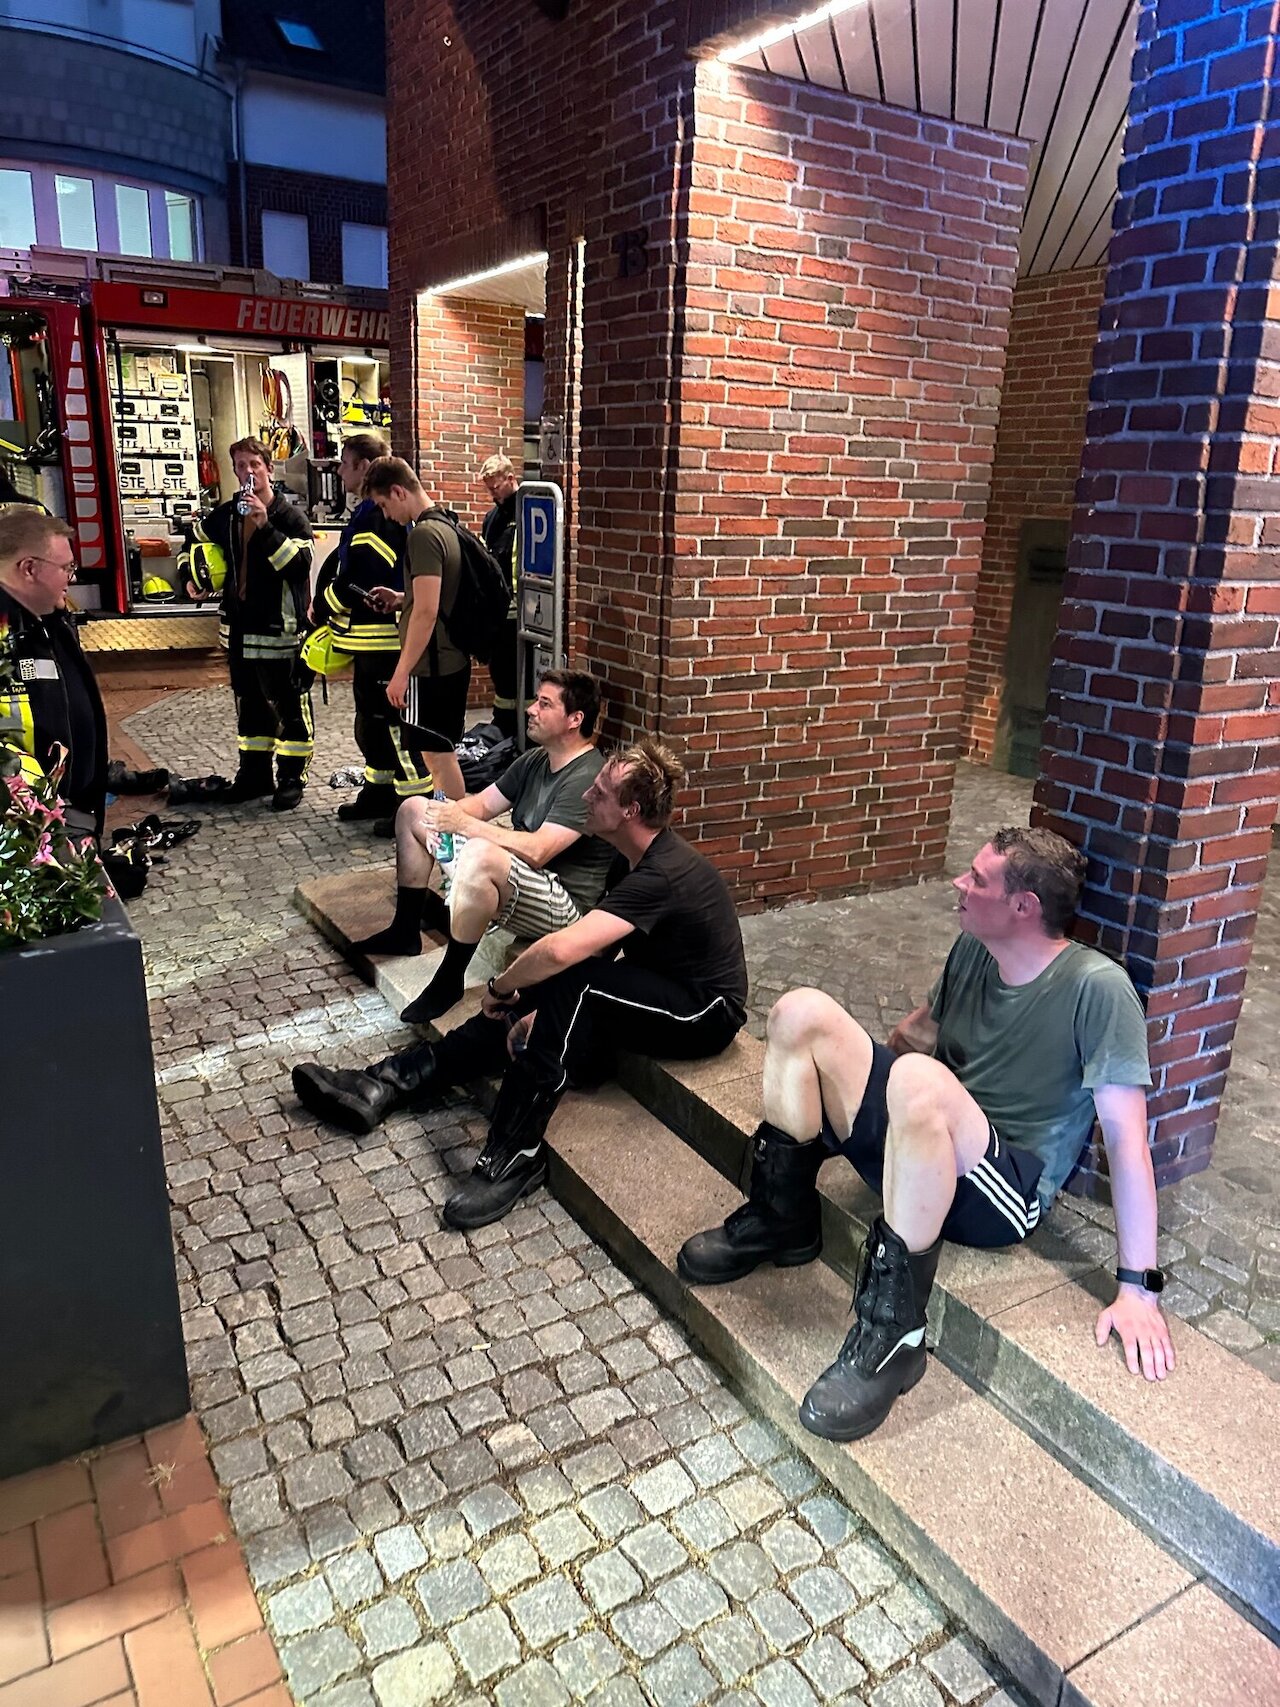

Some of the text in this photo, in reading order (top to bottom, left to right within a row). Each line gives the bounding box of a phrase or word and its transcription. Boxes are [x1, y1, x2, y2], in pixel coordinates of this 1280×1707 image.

[237, 299, 390, 341] FEUERWEHR
[120, 476, 145, 489] STE
[163, 478, 187, 489] STE
[530, 507, 548, 564] P
